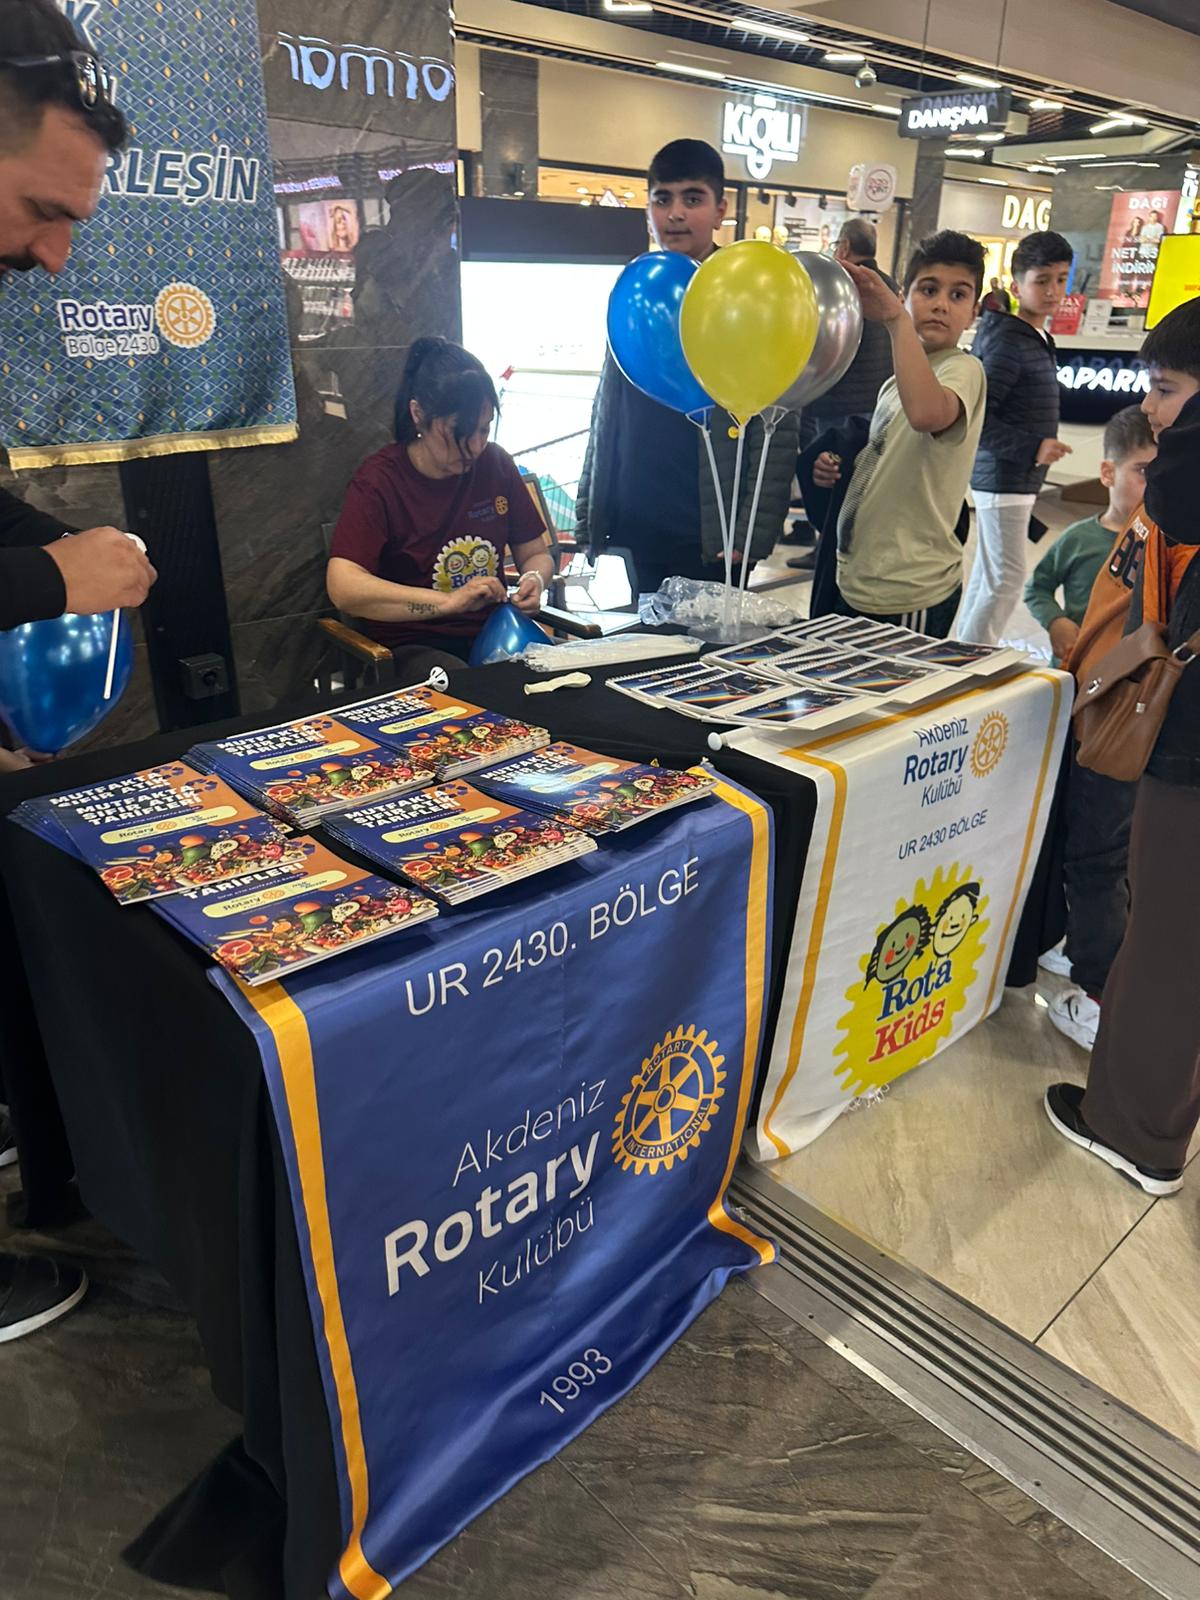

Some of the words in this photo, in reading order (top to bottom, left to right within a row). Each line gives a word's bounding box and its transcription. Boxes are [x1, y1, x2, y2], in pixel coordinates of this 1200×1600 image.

[907, 105, 988, 131] DANIŞMA
[100, 144, 258, 205] RLEŞİN
[1001, 194, 1052, 232] DAG
[1111, 259, 1156, 274] İNDİRİ
[60, 302, 152, 332] Rotary
[68, 337, 116, 357] Bölge
[118, 336, 158, 354] 2430
[216, 725, 316, 749] MUTFAKTA
[224, 739, 271, 753] SIFIR
[278, 729, 322, 744] ATIK
[913, 716, 969, 747] Akdeniz
[480, 751, 560, 779] MUTFAKTA
[903, 743, 969, 786] Rotary
[49, 771, 163, 805] MUTFAKTA
[76, 785, 195, 815] MUTFAKTA
[343, 790, 449, 819] MUTFAKTA
[921, 774, 963, 807] Kulübü
[81, 802, 138, 822] SIFIR
[148, 789, 197, 809] ATIK
[352, 808, 402, 825] SIFIR
[410, 795, 457, 813] ATIK
[898, 838, 917, 860] UR
[918, 825, 947, 854] 2430
[947, 809, 988, 841] BÖLGE
[405, 962, 469, 1016] UR
[482, 921, 577, 988] 2430.
[589, 856, 699, 940] BÖLGE
[876, 957, 953, 1022] Rota
[867, 998, 946, 1065] Kids
[647, 1040, 688, 1075] ROTARY
[452, 1079, 606, 1187] Akdeniz
[626, 1102, 711, 1158] INTERNATIONAL
[384, 1130, 600, 1296] Rotary
[478, 1197, 595, 1304] Kulübü
[539, 1347, 613, 1415] 1993
